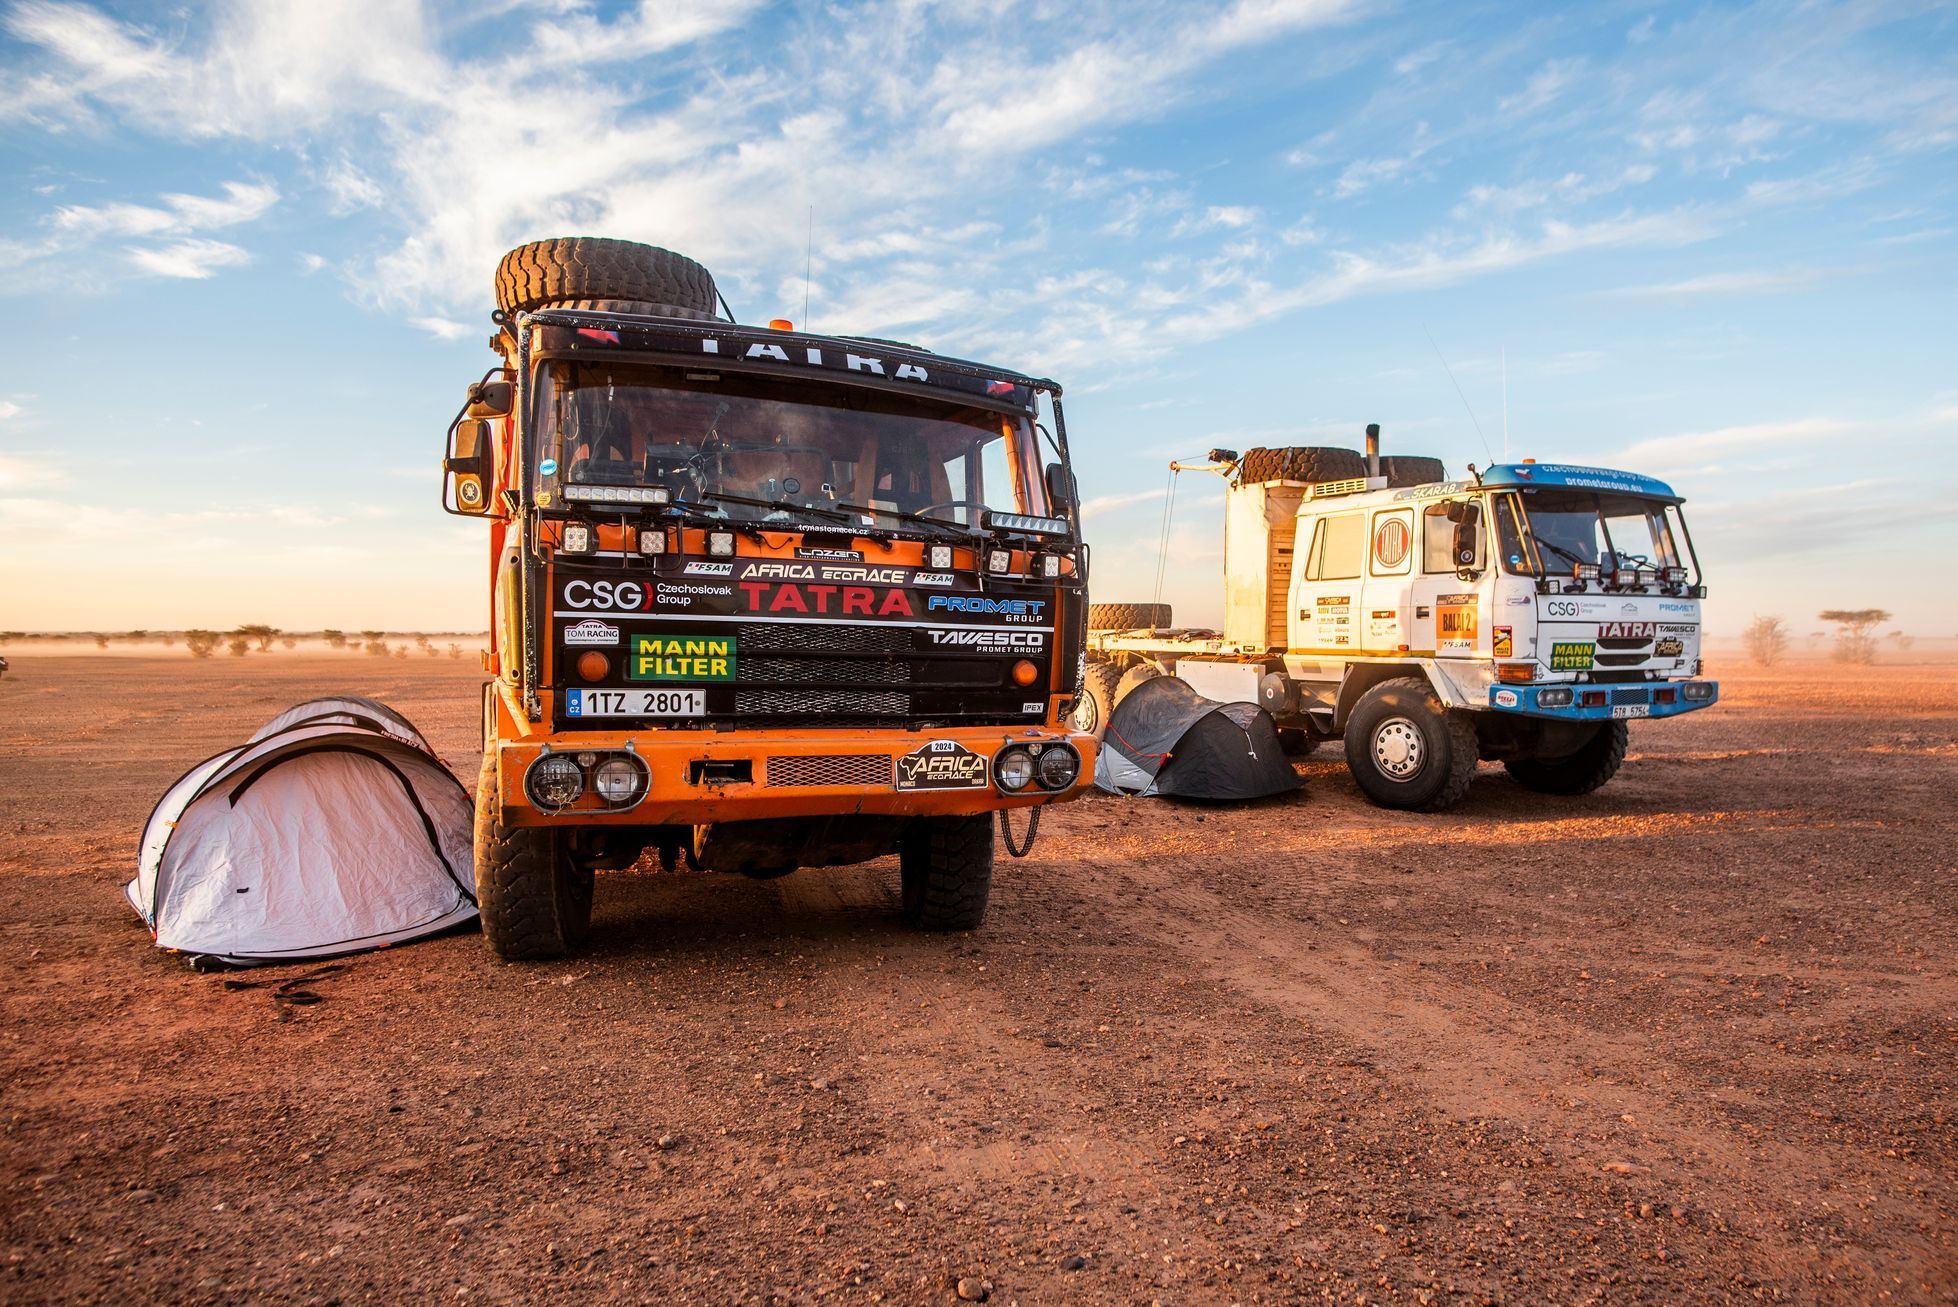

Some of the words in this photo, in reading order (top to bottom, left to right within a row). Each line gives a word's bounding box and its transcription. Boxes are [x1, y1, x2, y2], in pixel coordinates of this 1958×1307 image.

[1411, 483, 1457, 499] SKARAB
[698, 563, 733, 573] FSAM
[741, 563, 815, 580] AFRICA
[924, 574, 953, 583] FSAM
[564, 580, 643, 610] CSG
[657, 583, 732, 596] Czechoslovak
[657, 595, 691, 606] Group
[739, 581, 914, 617] TATRA
[928, 596, 1045, 615] PROMET
[1548, 602, 1576, 616] CSG
[1659, 604, 1695, 612] PROMET
[1006, 615, 1043, 623] GROUP
[1443, 613, 1465, 632] BALAI
[1466, 612, 1471, 632] 2
[567, 630, 586, 638] TOM
[587, 630, 618, 638] RACING
[1600, 622, 1655, 638] TATRA
[639, 640, 728, 657] MANN
[1014, 646, 1043, 654] GROUP
[1555, 644, 1593, 655] MANN
[639, 657, 728, 676] FILTER
[1553, 656, 1590, 668] FILTER
[569, 706, 580, 714] CZ
[587, 693, 626, 713] 1TZ
[643, 693, 695, 714] 2801
[935, 743, 952, 751] 2024
[911, 756, 984, 776] AFRICA
